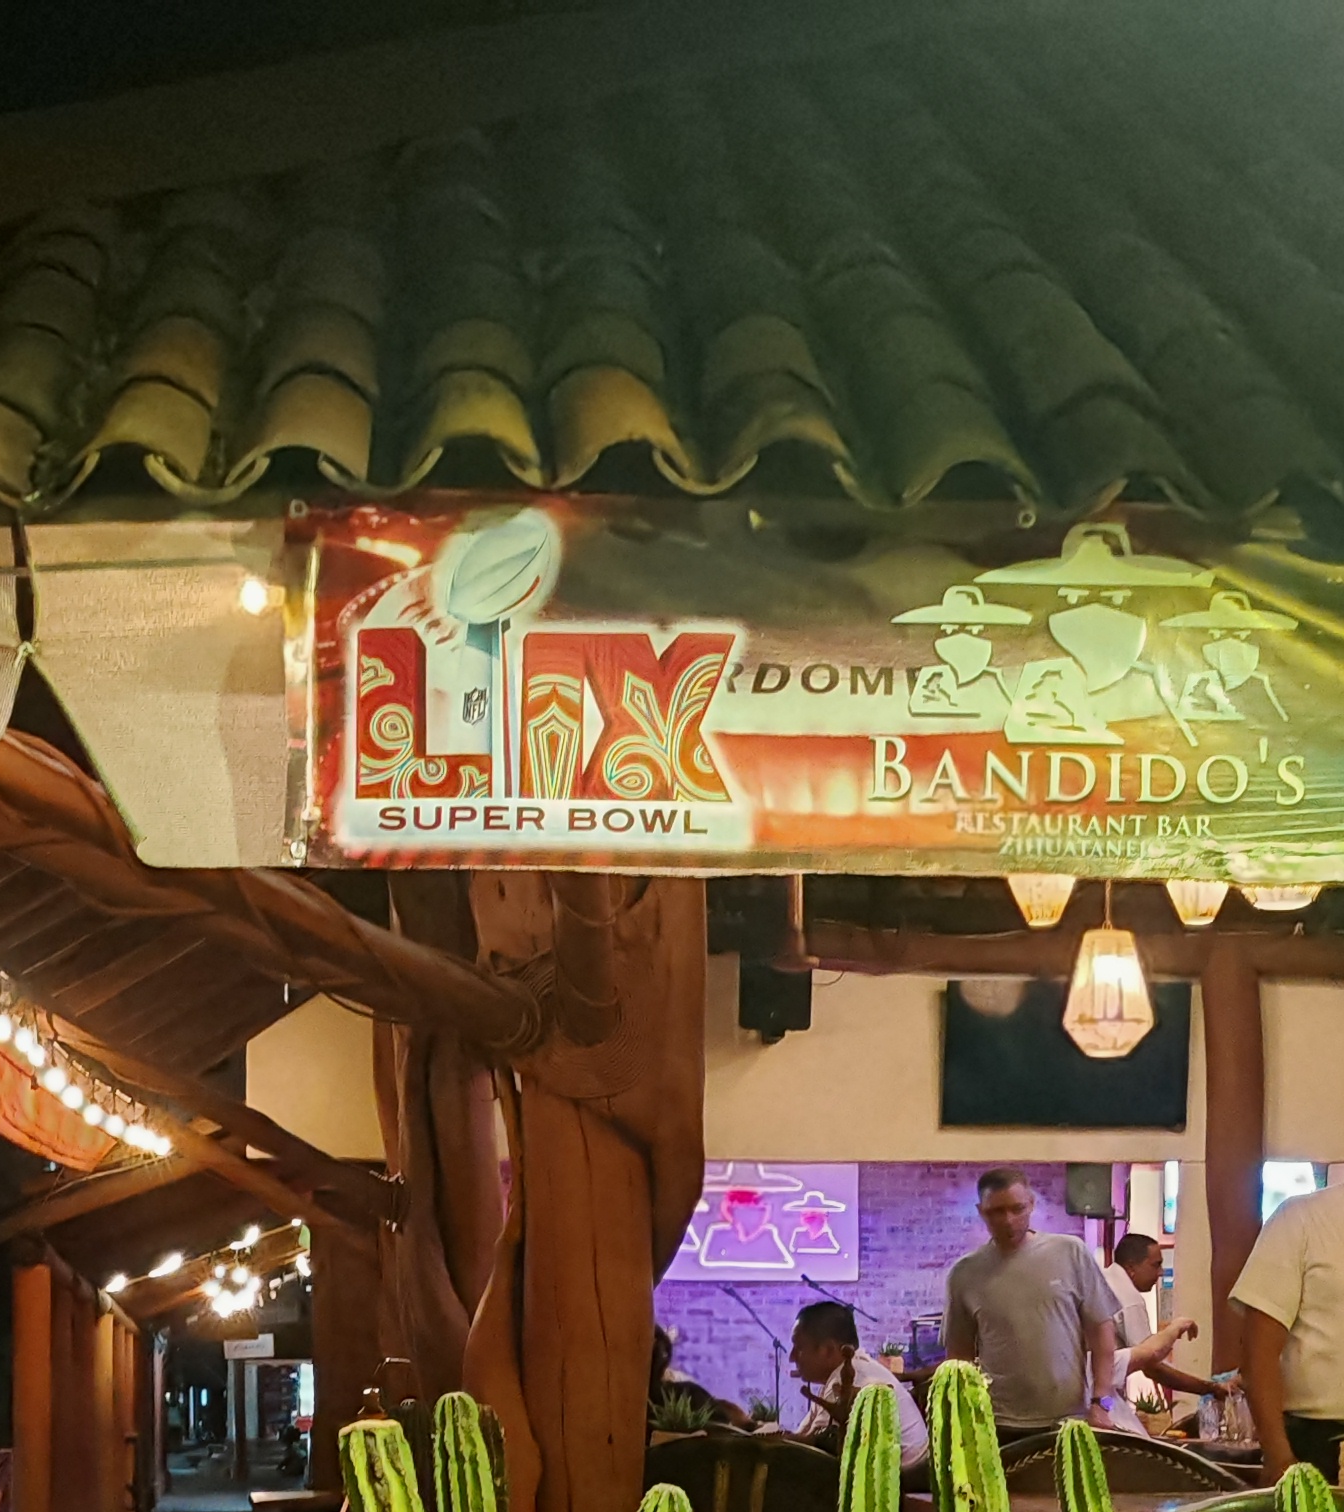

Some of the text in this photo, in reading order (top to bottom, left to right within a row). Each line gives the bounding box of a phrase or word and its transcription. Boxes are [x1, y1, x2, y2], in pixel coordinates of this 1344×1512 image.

[464, 701, 486, 722] NFL
[870, 737, 1306, 807] BANDIDO'S
[378, 802, 709, 835] SUPER BOWL
[954, 811, 1214, 839] RESTAURANT BAR
